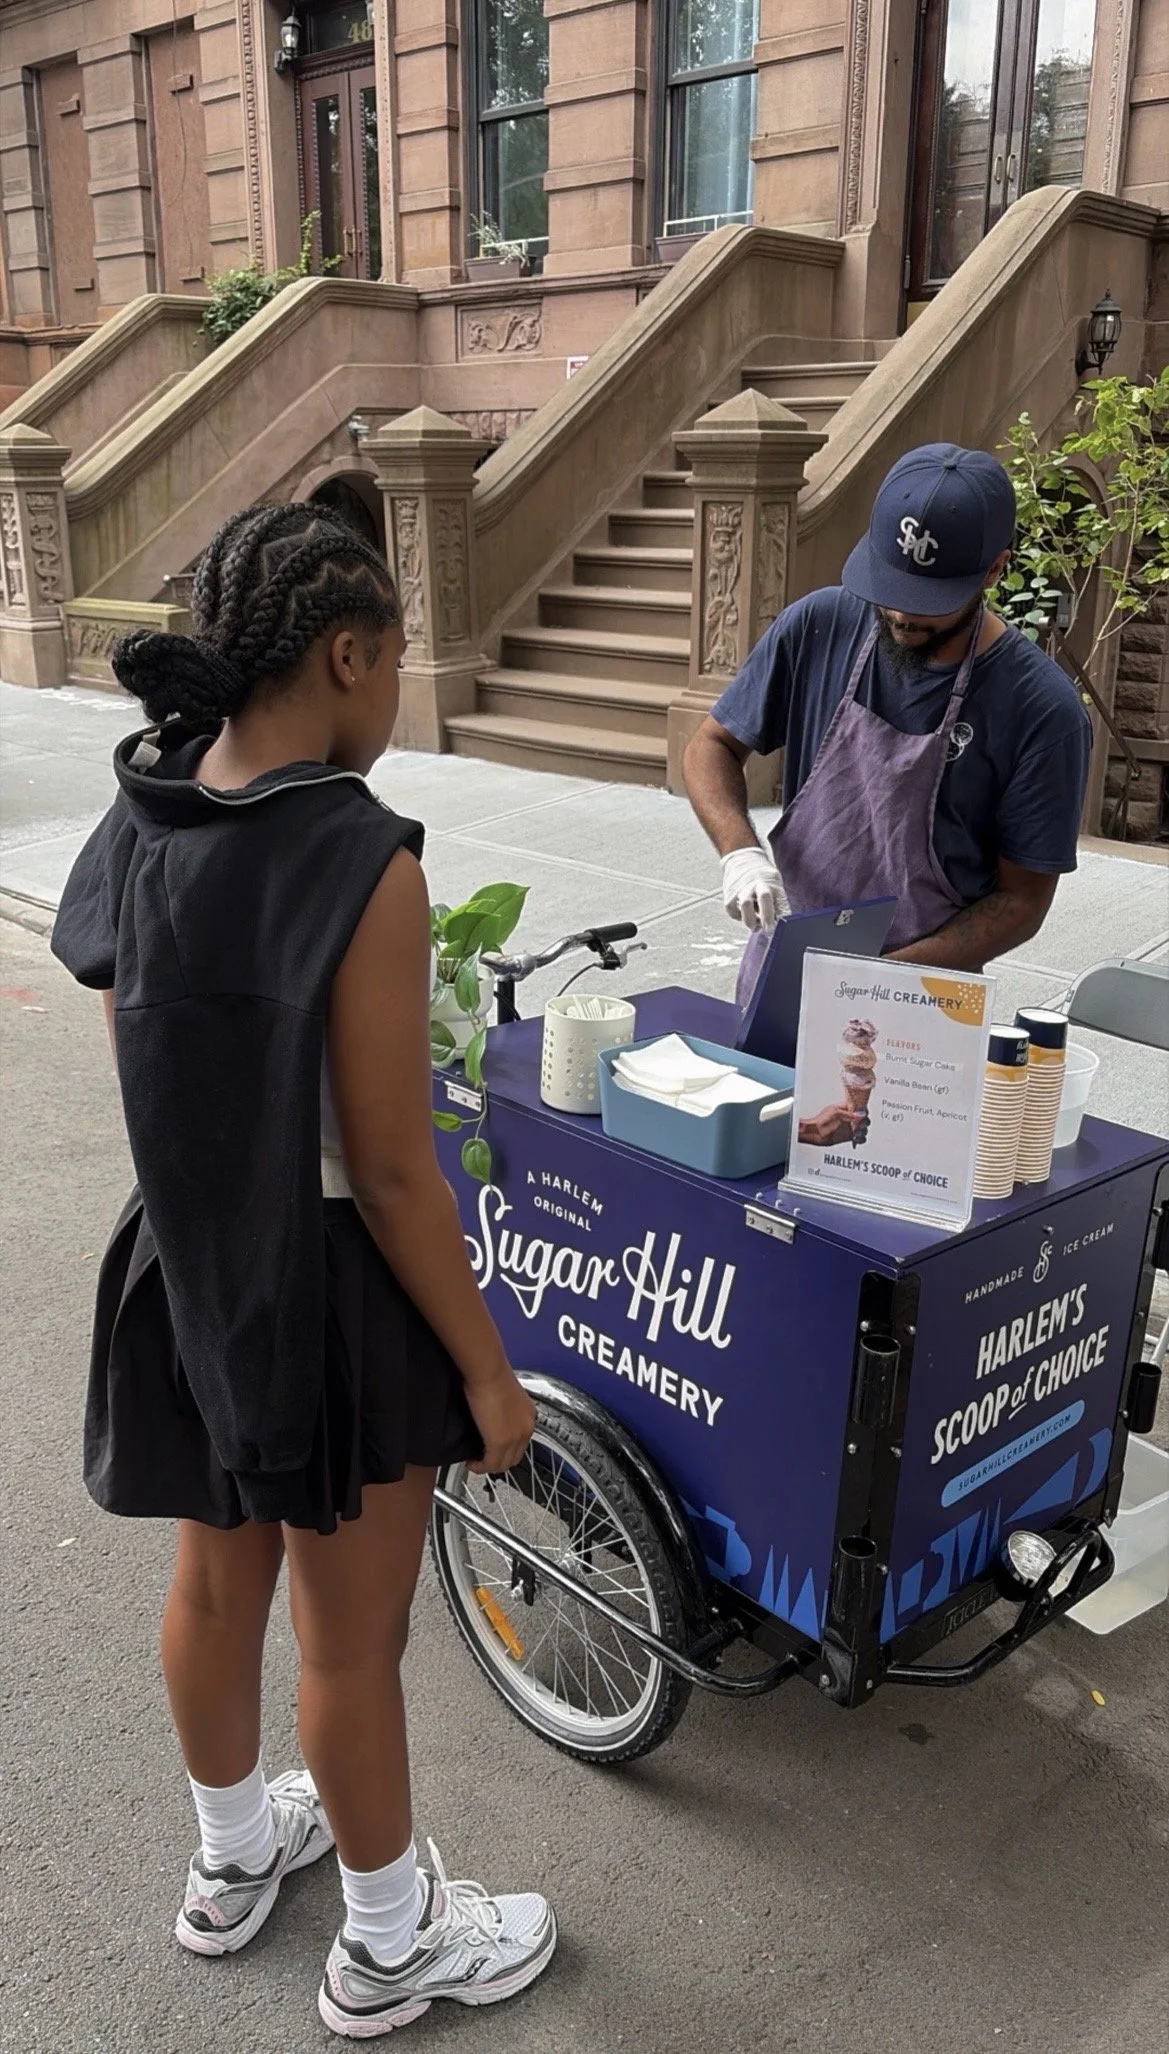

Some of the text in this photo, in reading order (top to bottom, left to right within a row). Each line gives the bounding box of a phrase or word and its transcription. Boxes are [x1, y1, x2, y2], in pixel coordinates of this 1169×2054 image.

[834, 980, 963, 1011] Sugar Hill CREAMERY
[885, 1053, 956, 1072] Burnt Sugar Cake
[886, 1038, 921, 1051] FLAVORS
[884, 1076, 910, 1088] Vanilla
[911, 1081, 933, 1092] Bean
[882, 1099, 968, 1122] Passion Fruit, Apricot
[823, 1153, 869, 1173] HARLEM'S
[871, 1163, 901, 1179] SCOOP
[902, 1169, 913, 1182] of
[913, 1171, 949, 1189] CHOICE
[527, 1170, 603, 1217] A HARLEM
[533, 1196, 592, 1232] ORIGINAL
[463, 1184, 736, 1349] Sugar Hill
[965, 1266, 1025, 1304] HANDMADE
[1063, 1239, 1080, 1256] ICE
[1082, 1223, 1114, 1247] CREAM
[976, 1283, 1088, 1380] HARLEM'S
[557, 1315, 724, 1427] CREAMERY
[931, 1325, 1110, 1465] SCOOP of CHOICE
[958, 1414, 1072, 1491] SUGARHILLCREAMERY.COM
